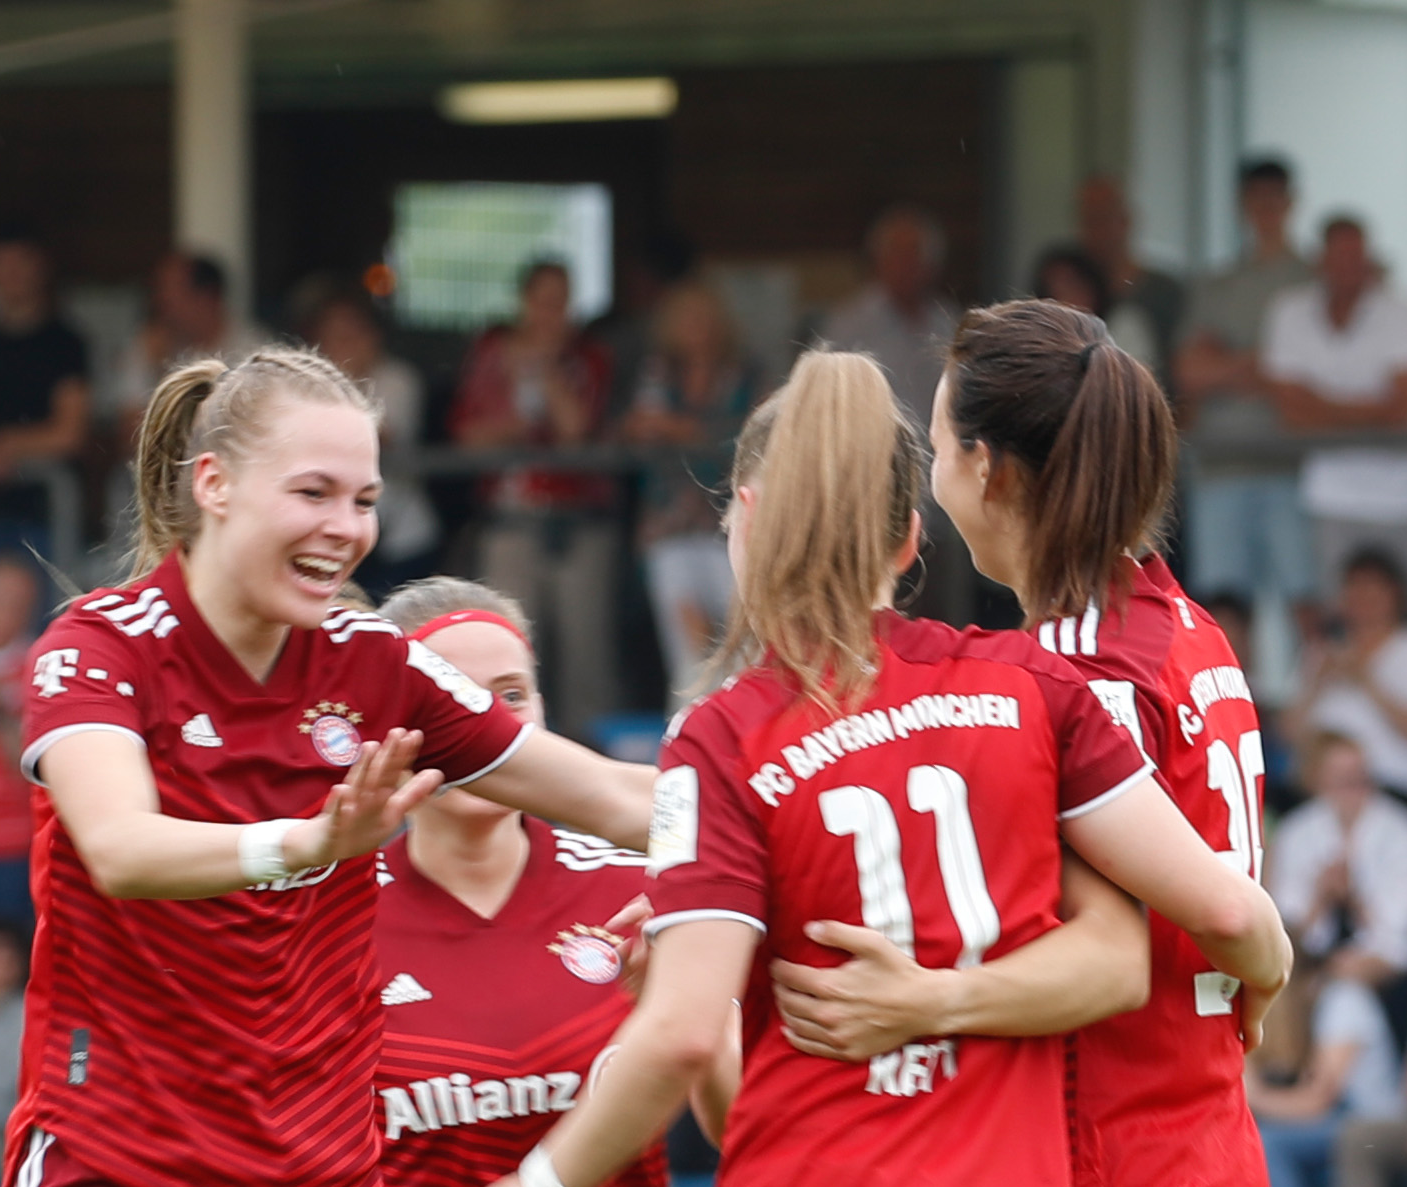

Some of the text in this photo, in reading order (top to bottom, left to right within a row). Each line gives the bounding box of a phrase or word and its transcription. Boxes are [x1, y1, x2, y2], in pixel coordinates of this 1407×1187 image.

[747, 762, 797, 808] FC
[780, 709, 896, 781] BAYERN
[818, 765, 1001, 969] 11
[379, 1071, 582, 1140] Allianz
